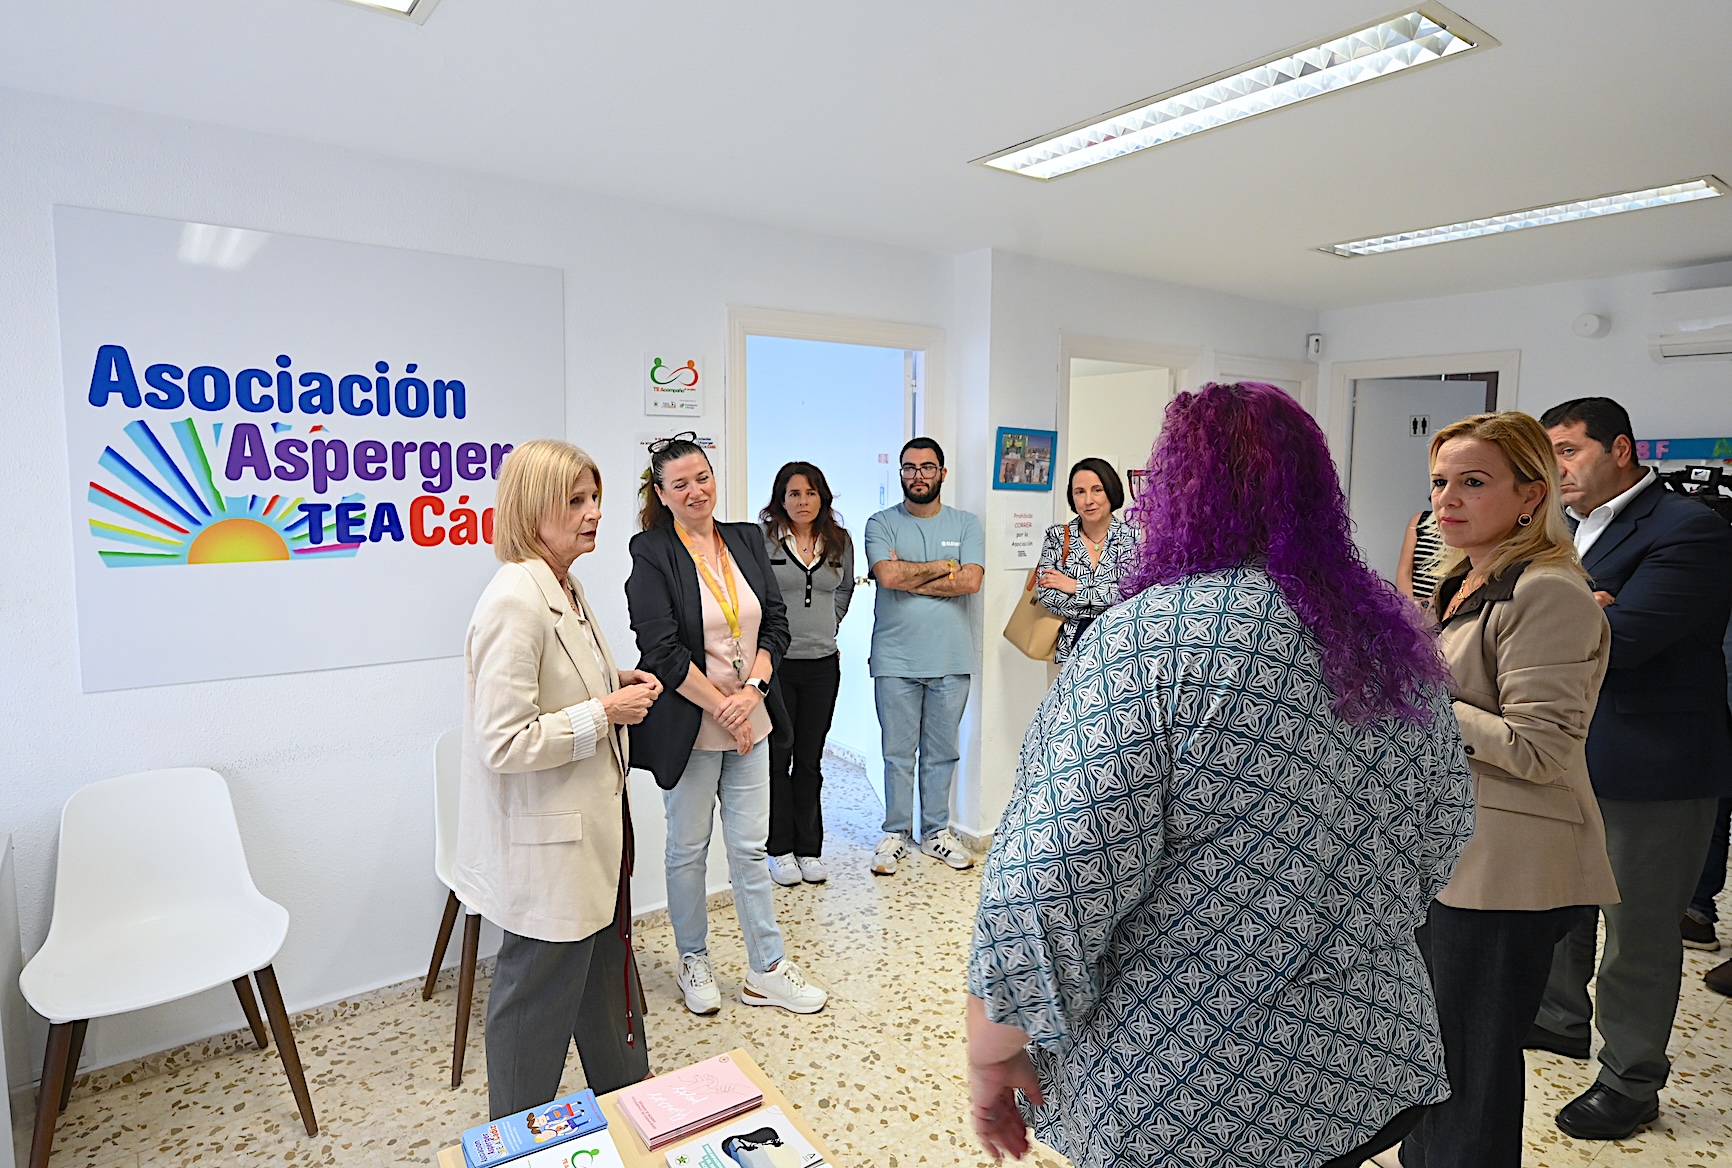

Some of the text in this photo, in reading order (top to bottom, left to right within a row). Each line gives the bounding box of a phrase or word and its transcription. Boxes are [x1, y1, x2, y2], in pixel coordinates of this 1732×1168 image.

[88, 344, 467, 419] Asociación
[224, 423, 513, 494] Asperger
[297, 502, 404, 544] TEA
